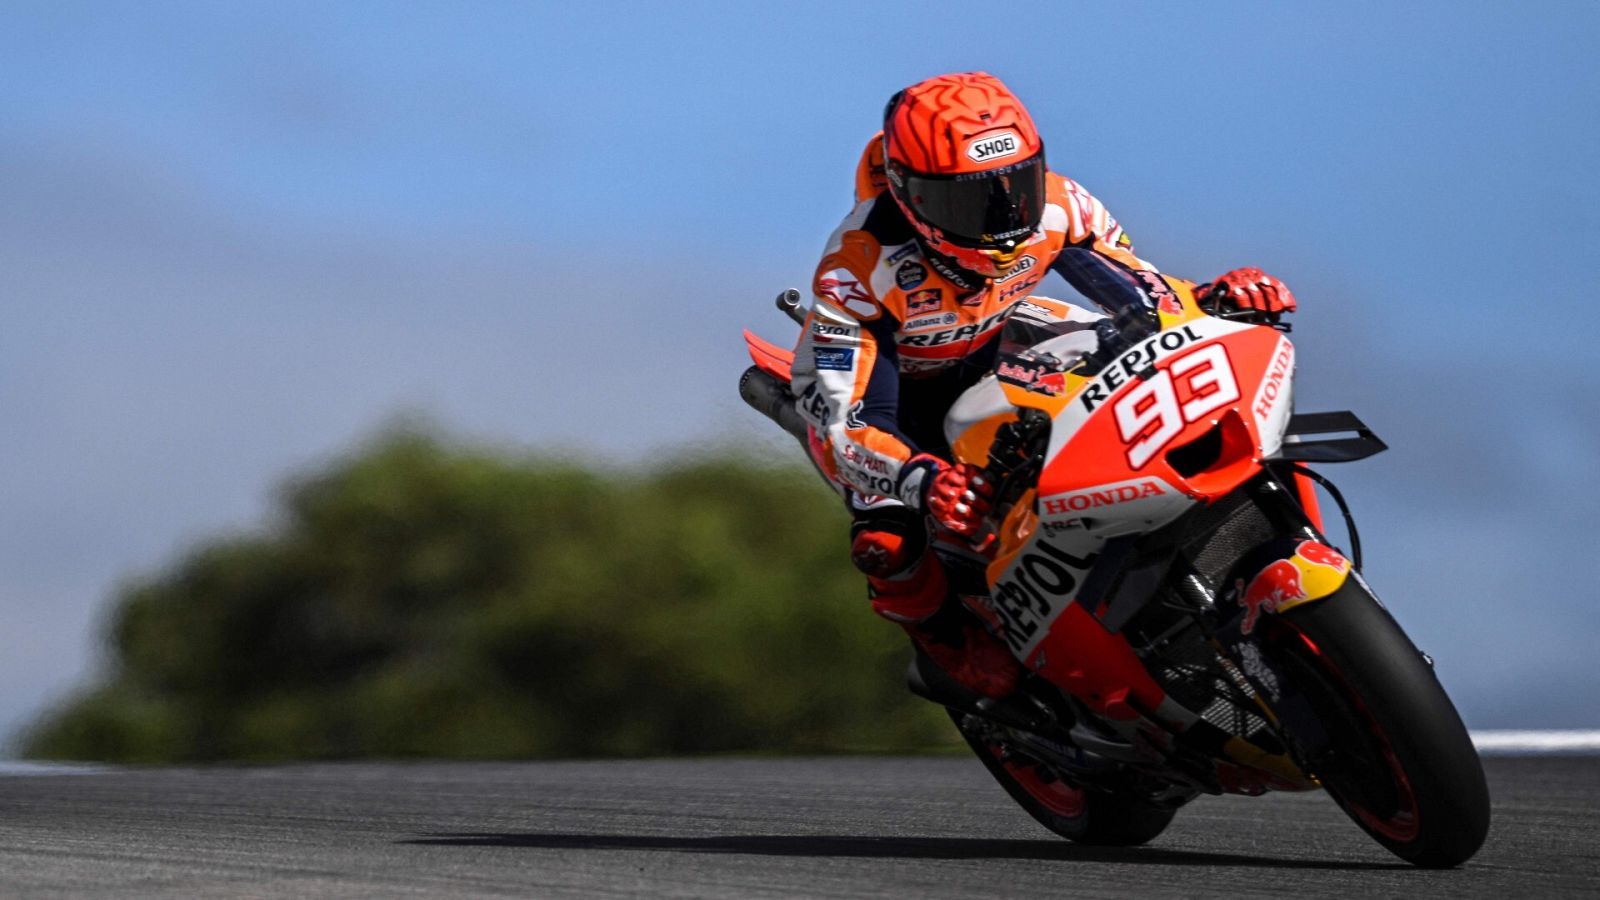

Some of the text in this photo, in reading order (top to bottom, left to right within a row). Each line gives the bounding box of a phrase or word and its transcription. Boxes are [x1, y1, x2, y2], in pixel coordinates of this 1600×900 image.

[974, 136, 1016, 158] SHOEI
[992, 166, 1012, 176] YOU
[929, 257, 971, 289] REPSOL
[905, 317, 941, 330] Allianz
[1080, 326, 1202, 412] REPSOL
[1255, 341, 1293, 419] HONDA
[1113, 342, 1240, 471] 93
[1043, 481, 1167, 516] HONDA
[995, 538, 1099, 651] REPSOL
